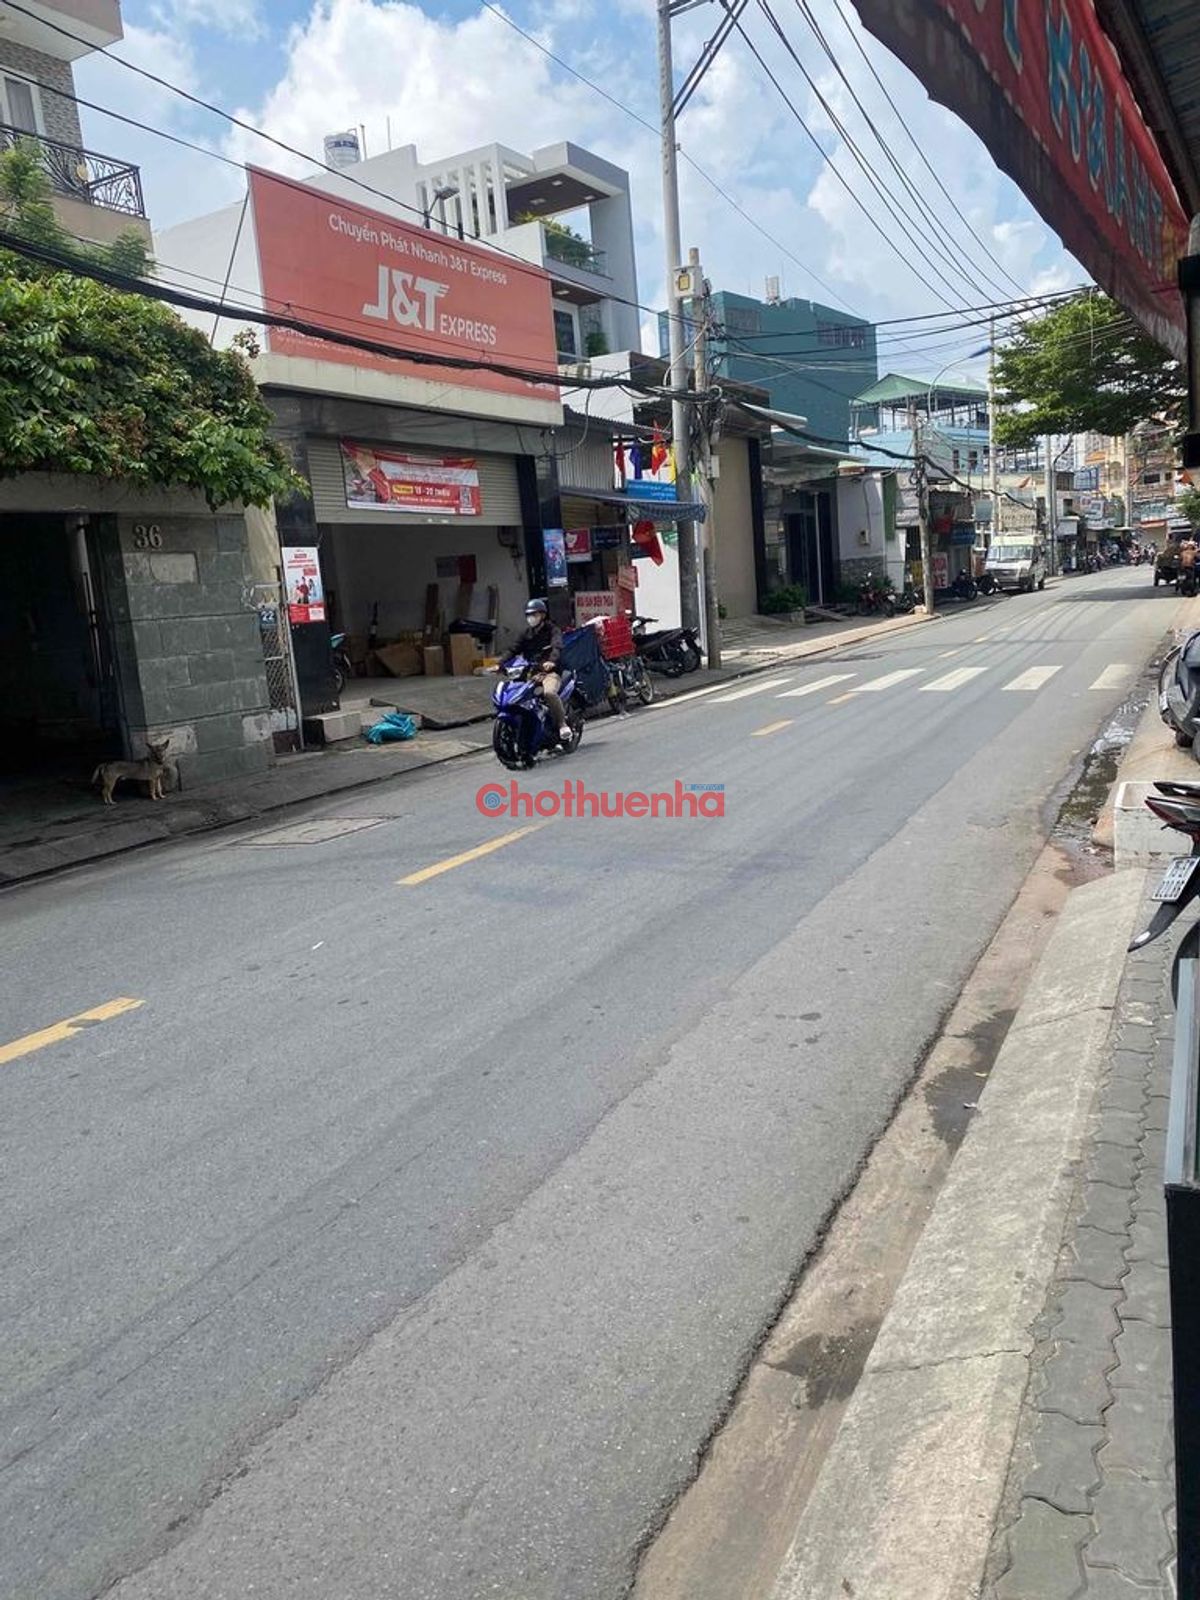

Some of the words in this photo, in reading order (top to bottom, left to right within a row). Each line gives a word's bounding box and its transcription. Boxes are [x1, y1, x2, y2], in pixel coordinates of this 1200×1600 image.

[381, 231, 410, 255] Phát
[411, 241, 449, 267] Nhanh
[449, 255, 469, 273] J&T
[470, 260, 508, 286] Express
[362, 264, 450, 332] J&T
[440, 314, 497, 346] EXPRESS
[134, 524, 163, 549] 36
